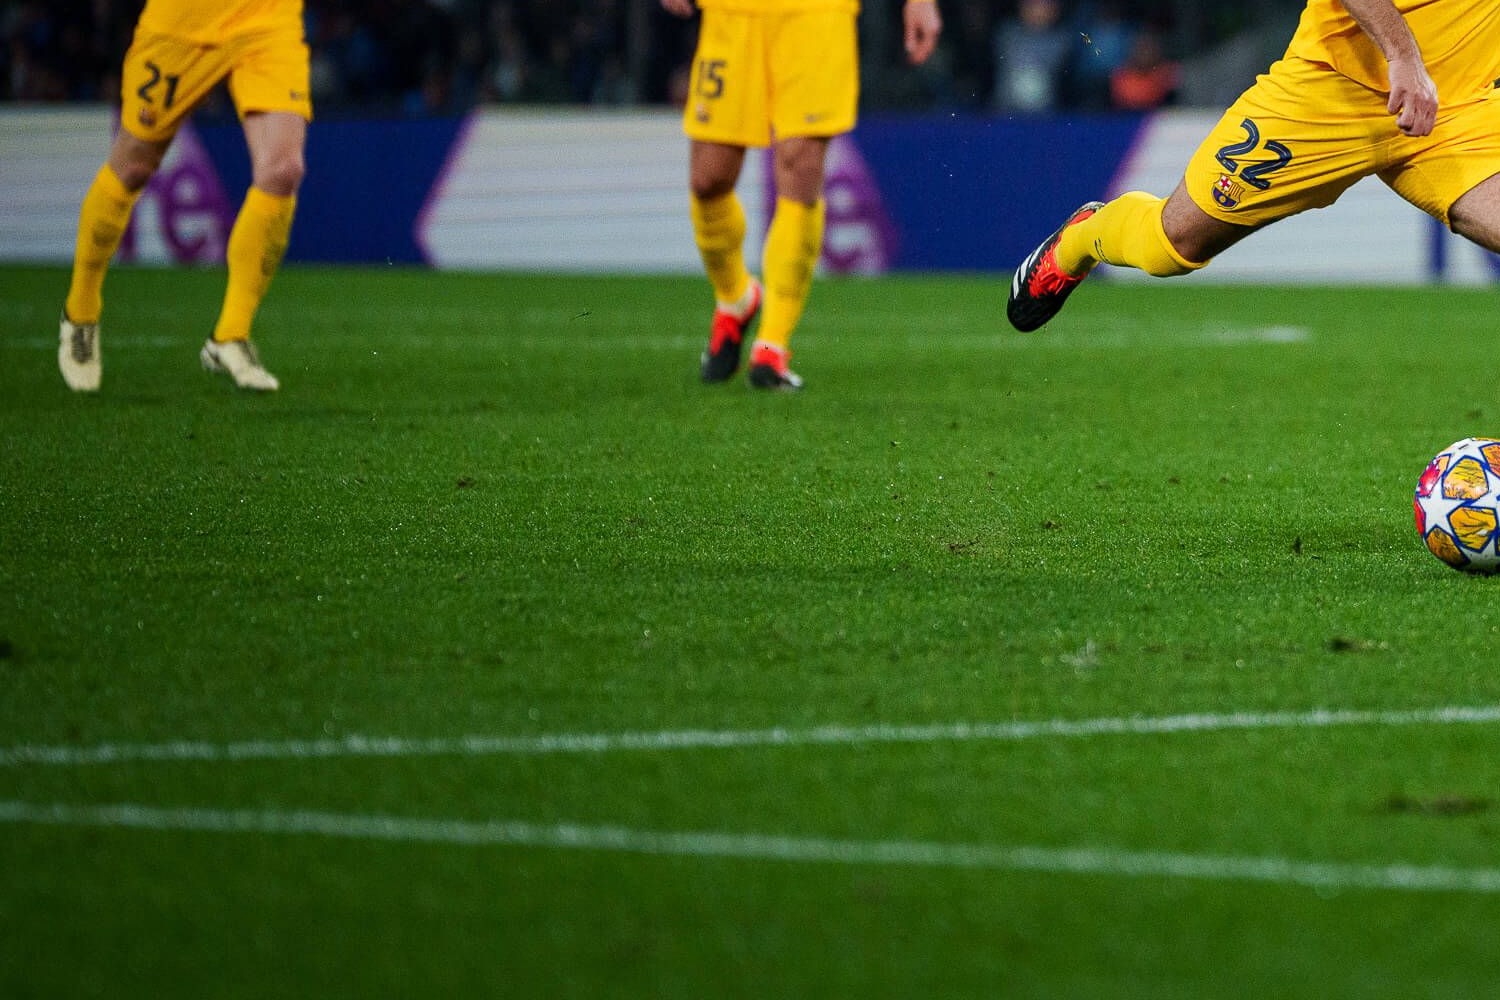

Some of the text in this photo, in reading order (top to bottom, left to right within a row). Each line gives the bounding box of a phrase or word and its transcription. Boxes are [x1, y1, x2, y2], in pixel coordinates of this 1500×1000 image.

[137, 60, 181, 111] 21
[698, 58, 728, 101] 15
[1215, 118, 1293, 191] 22
